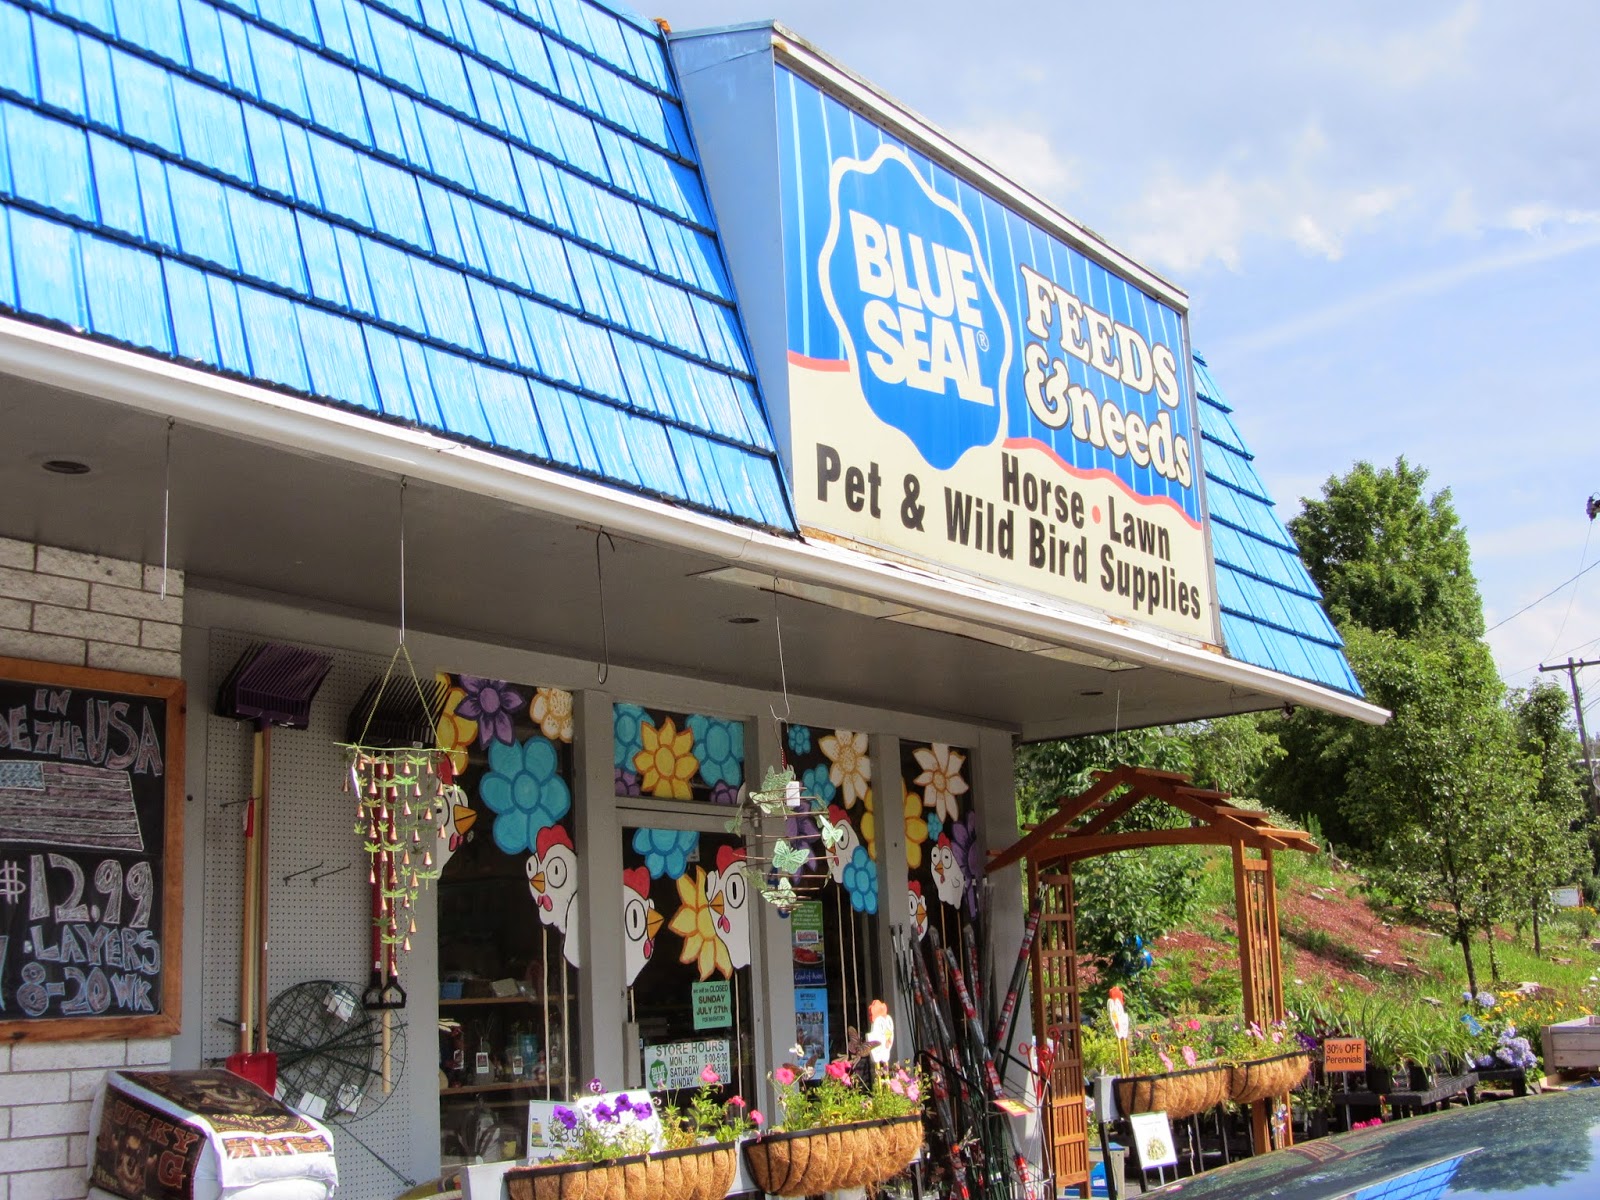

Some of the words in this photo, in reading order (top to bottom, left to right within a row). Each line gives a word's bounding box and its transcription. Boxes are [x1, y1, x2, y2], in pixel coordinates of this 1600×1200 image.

[849, 209, 984, 328] BLUE
[1020, 264, 1180, 409] FEEDS
[863, 301, 994, 407] SEAL
[1001, 452, 1085, 530] Horse
[1107, 495, 1171, 562] Lawn
[816, 443, 882, 519] Pet
[900, 473, 925, 532] &
[943, 486, 1014, 561] Wild
[1028, 518, 1087, 584] Bird
[1100, 544, 1201, 620] Supplies
[34, 689, 72, 716] IN
[33, 719, 88, 761] THE
[86, 698, 164, 777] USA
[30, 924, 160, 975] LAYERS
[17, 962, 111, 1016] 8-20
[110, 973, 154, 1012] WK
[698, 994, 725, 1004] SUNDAY
[710, 985, 729, 993] CLOSED
[697, 1006, 712, 1015] JULY
[713, 1005, 729, 1014] 27th
[656, 1043, 688, 1056] STORE
[692, 1041, 724, 1053] HOURS
[1326, 1044, 1343, 1053] 30%
[1345, 1044, 1361, 1053] OFF
[1326, 1055, 1362, 1064] Perennials
[670, 1065, 699, 1078] SATURDAY
[671, 1077, 694, 1088] SUNDAY
